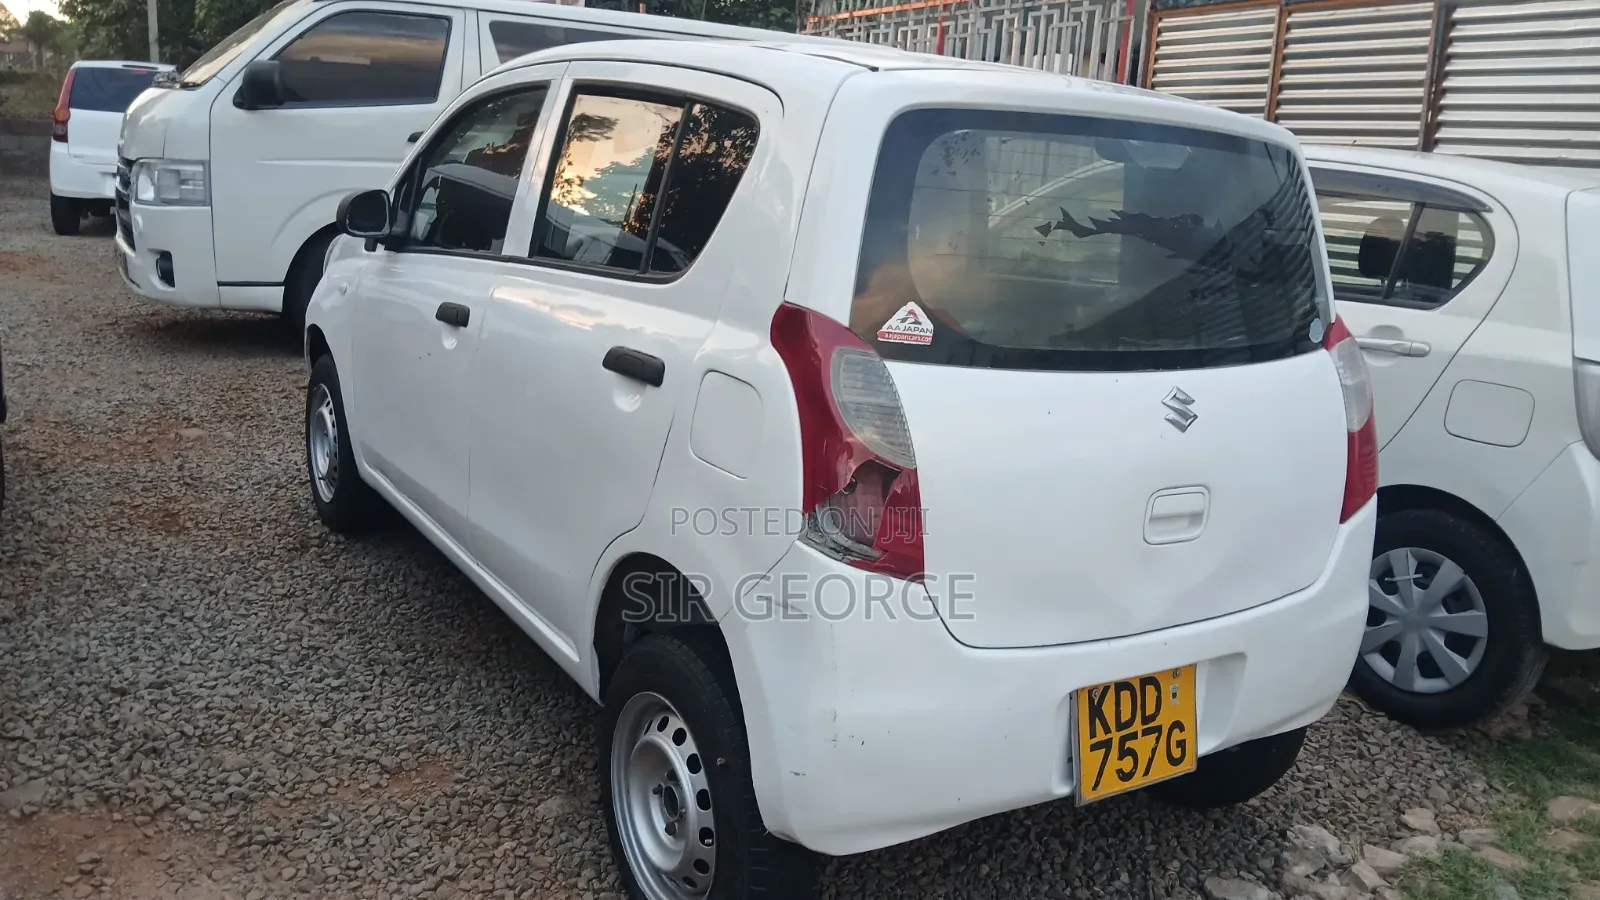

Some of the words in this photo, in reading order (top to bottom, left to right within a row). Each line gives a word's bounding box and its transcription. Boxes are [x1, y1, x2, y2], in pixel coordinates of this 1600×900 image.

[902, 326, 932, 334] JAPAN
[1088, 676, 1162, 739] KDD
[1090, 720, 1186, 791] 757G
